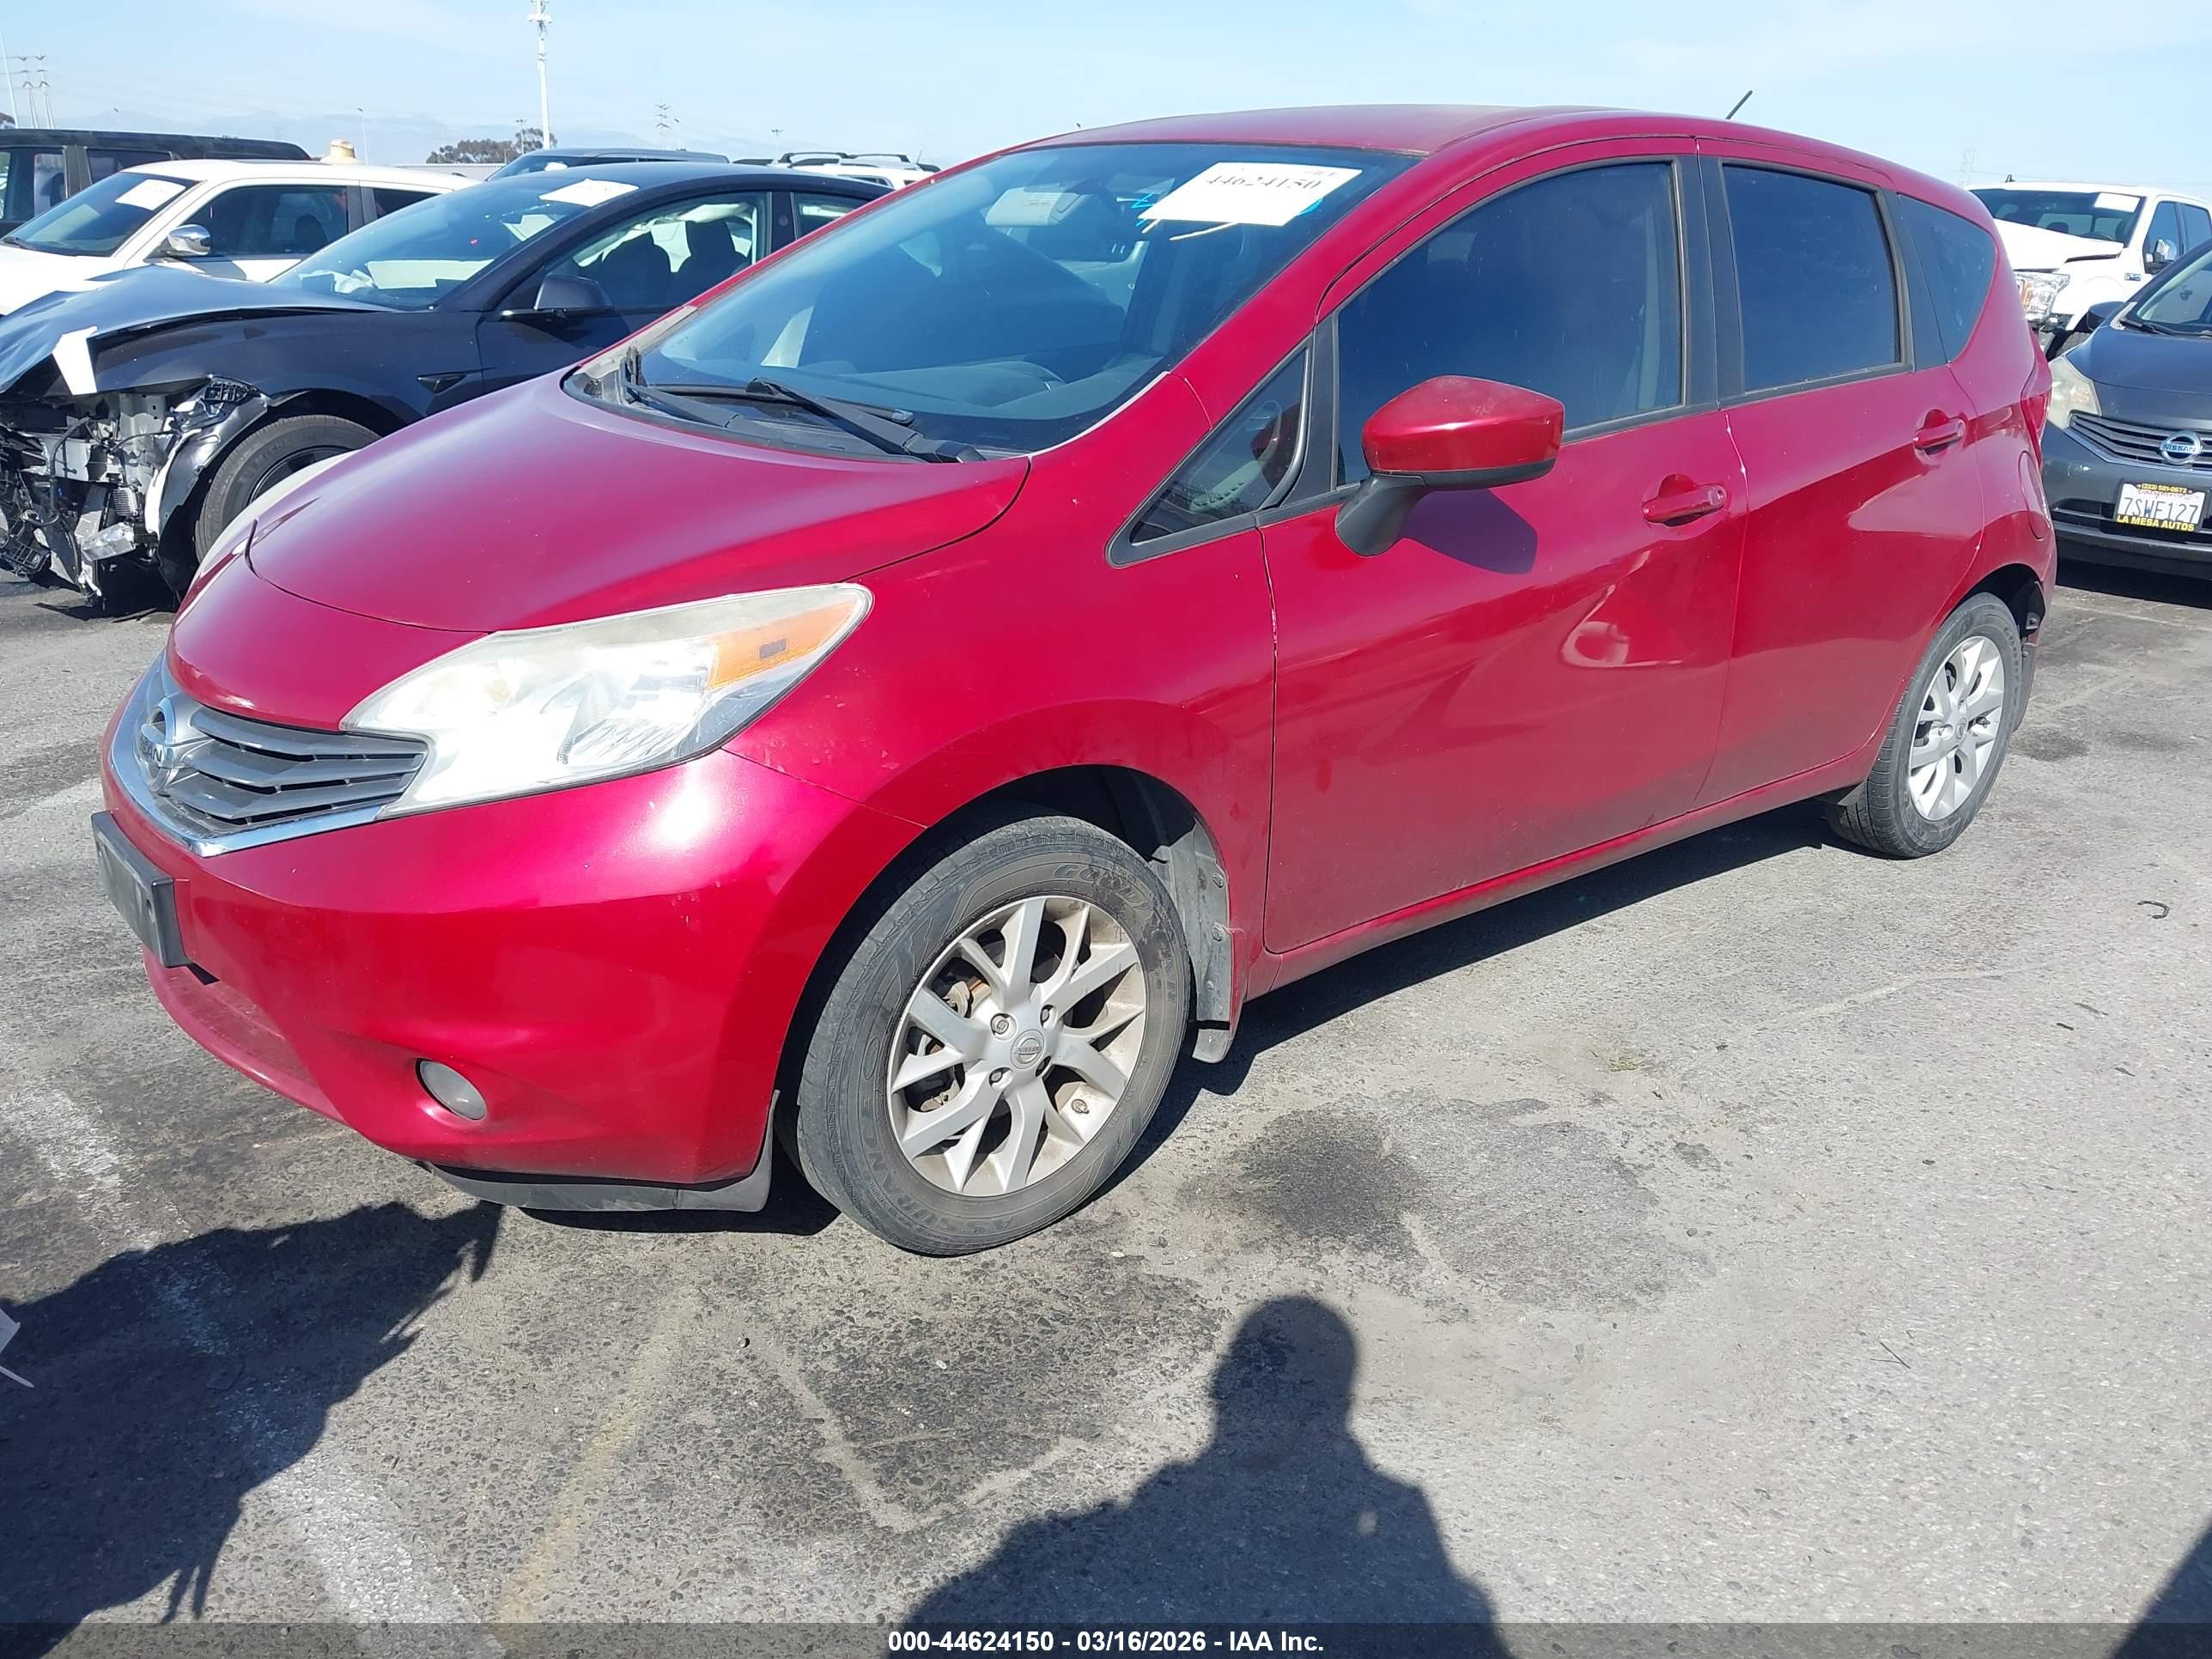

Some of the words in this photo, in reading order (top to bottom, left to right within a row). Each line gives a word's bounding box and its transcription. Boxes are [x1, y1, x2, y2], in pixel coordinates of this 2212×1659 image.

[1206, 175, 1323, 189] 44624150
[2163, 444, 2197, 453] NISSAN
[2117, 514, 2129, 524] LA
[2130, 516, 2160, 527] MESA
[2160, 520, 2195, 532] AUTOS
